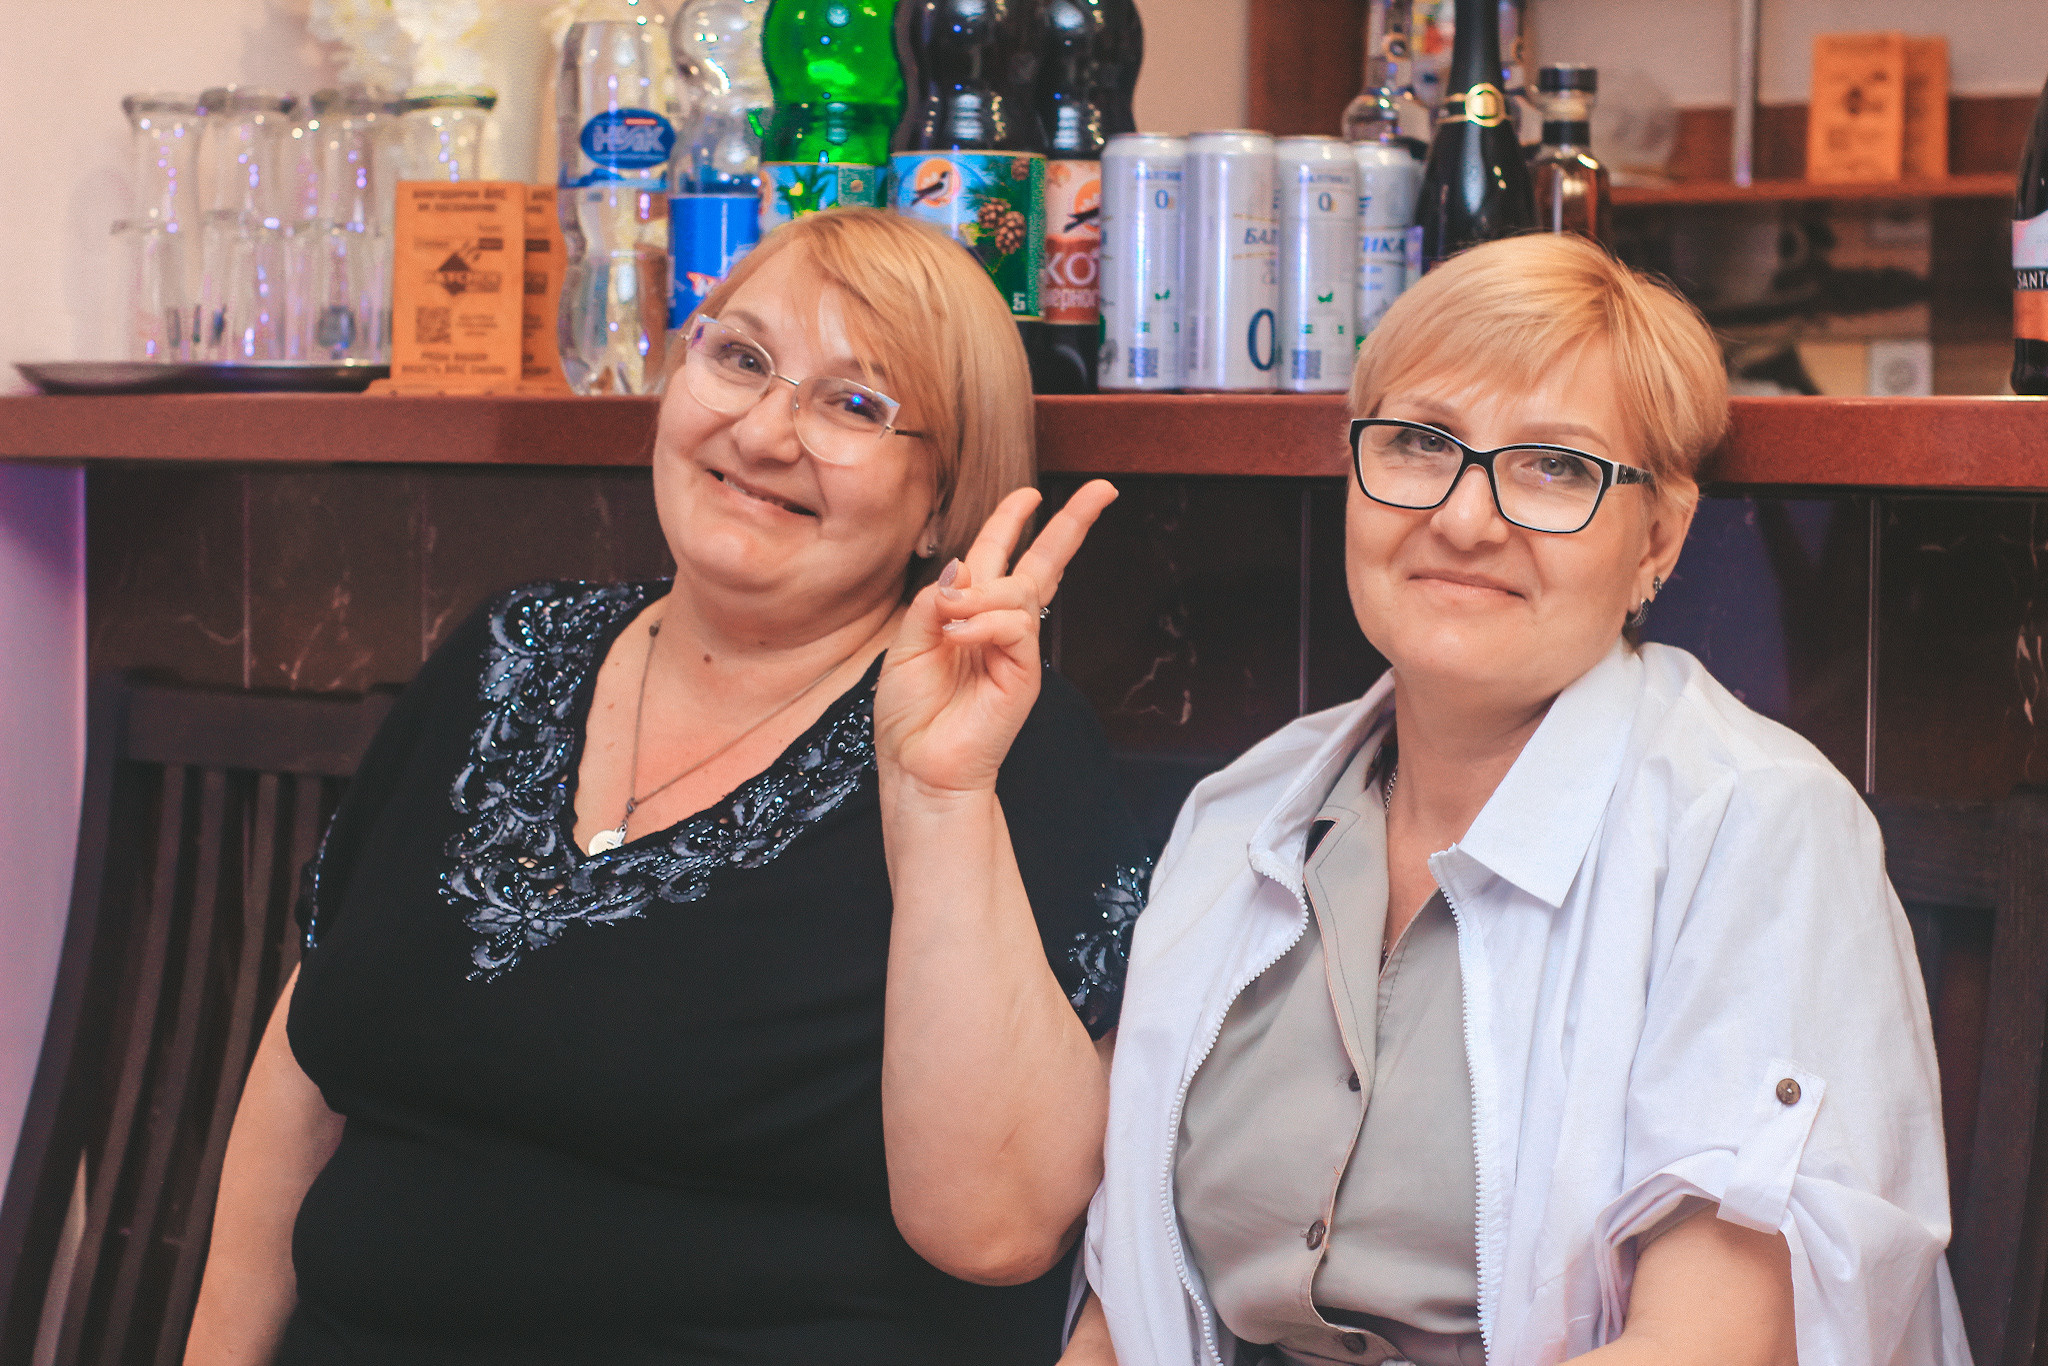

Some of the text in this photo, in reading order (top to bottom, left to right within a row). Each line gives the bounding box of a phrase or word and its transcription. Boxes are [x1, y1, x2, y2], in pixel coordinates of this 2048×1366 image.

[1154, 189, 1169, 209] 0
[1318, 192, 1332, 211] 0
[1044, 249, 1100, 286] КО
[2017, 269, 2048, 290] SANT
[1247, 308, 1276, 371] 0
